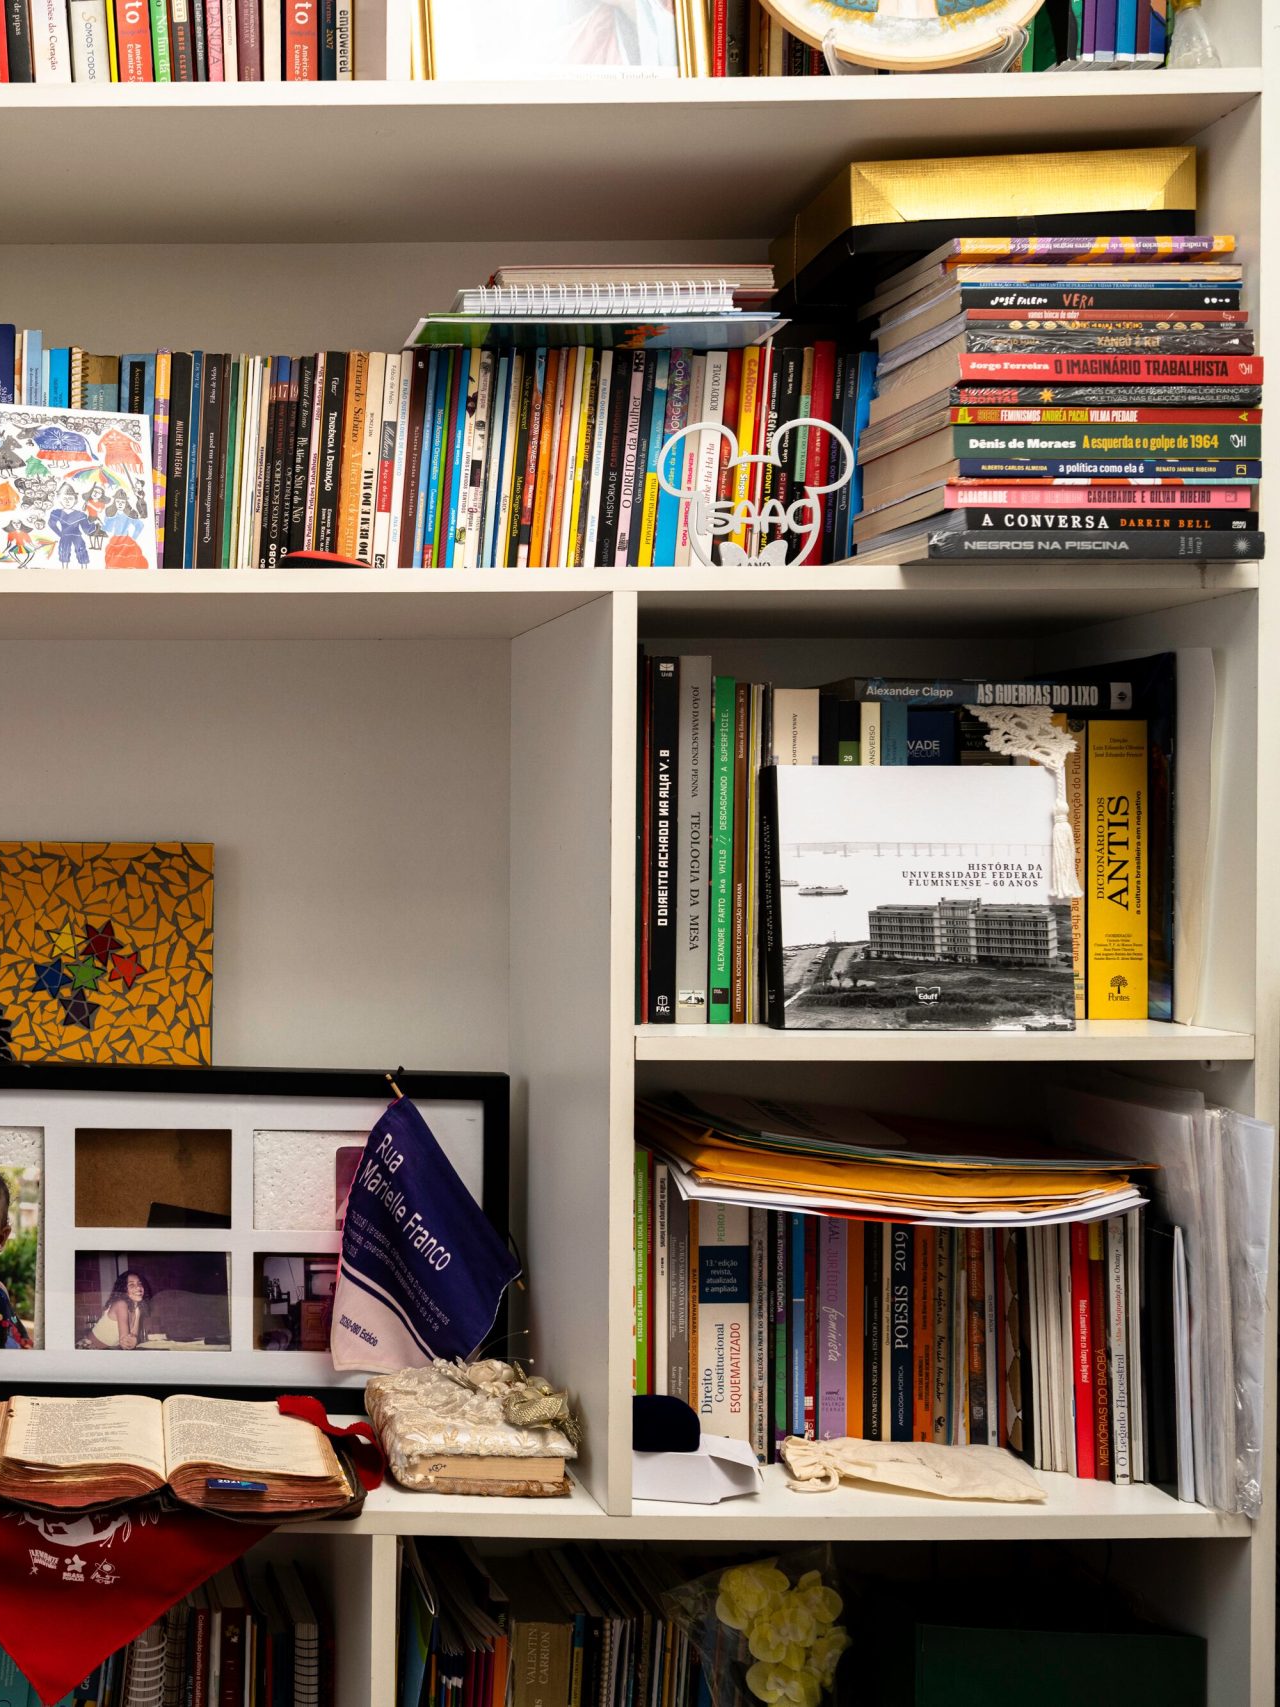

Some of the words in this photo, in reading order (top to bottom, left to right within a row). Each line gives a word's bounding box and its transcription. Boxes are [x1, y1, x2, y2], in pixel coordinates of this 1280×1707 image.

[338, 10, 349, 73] empowered
[675, 360, 685, 399] AMADO
[970, 362, 1001, 372] Jorge
[1003, 362, 1050, 370] Ferreira
[1054, 360, 1062, 375] O
[1066, 356, 1141, 376] IMAGINÁRIO
[1145, 360, 1229, 377] TRABALHISTA
[176, 420, 185, 444] MULHER
[629, 396, 642, 437] Mulher
[671, 400, 683, 433] JORGE
[626, 438, 637, 455] da
[969, 438, 1006, 449] Dênis
[1008, 438, 1025, 449] de
[1027, 439, 1076, 449] Moraes
[1082, 436, 1090, 448] A
[1091, 435, 1135, 452] esquerda
[1136, 438, 1142, 449] e
[1143, 438, 1149, 449] o
[1150, 436, 1178, 452] golpe
[1178, 436, 1189, 449] de
[1190, 435, 1219, 449] 1964
[174, 446, 183, 479] INTEGRAL
[624, 457, 635, 498] DIREITO
[274, 460, 282, 504] ESCOLHIDOS
[622, 498, 631, 509] O
[696, 499, 818, 537] ISAAC
[270, 505, 280, 539] CONTOS
[982, 514, 994, 527] A
[1004, 514, 1110, 529] CONVERSA
[1120, 518, 1171, 528] DARRIN
[1178, 520, 1212, 529] BELL
[964, 541, 1034, 550] NEGROS
[1038, 541, 1061, 550] NA
[1065, 542, 1130, 550] PISCINA
[691, 685, 700, 709] JOÃO
[866, 686, 920, 696] Alexander
[922, 686, 954, 698] Clapp
[977, 684, 994, 704] AS
[995, 684, 1050, 705] GUERRAS
[1053, 685, 1070, 705] DO
[1071, 685, 1099, 706] LIXO
[691, 710, 700, 767] DAMASCENO
[907, 740, 940, 750] VADE
[691, 770, 699, 798] PENNA
[690, 812, 701, 885] TEOLOGIA
[1136, 829, 1142, 841] em
[968, 862, 1023, 871] HISTÓRIA
[1095, 824, 1105, 899] DICIONÁRIO
[1107, 795, 1130, 911] ANTIS
[902, 871, 987, 879] UNIVERSIDADE
[689, 888, 700, 907] DA
[688, 916, 700, 951] MESA
[1108, 992, 1130, 1002] Pontes
[376, 1133, 405, 1175] Rua
[359, 1159, 406, 1224] Marielle
[402, 1212, 452, 1272] Franco
[894, 1231, 909, 1272] 2019
[706, 1277, 737, 1285] atualizada
[710, 1286, 738, 1295] ampliada
[895, 1285, 909, 1350] POESIS
[714, 1322, 725, 1404] Constitucional
[730, 1322, 741, 1414] ESQUEMATIZADO
[1097, 1348, 1107, 1384] BAOBÁ
[701, 1368, 713, 1415] Direito
[1098, 1386, 1107, 1404] DO
[1098, 1408, 1109, 1467] MEMÓRIAS
[526, 1628, 538, 1685] VALENTIN
[538, 1631, 551, 1685] CARRION
